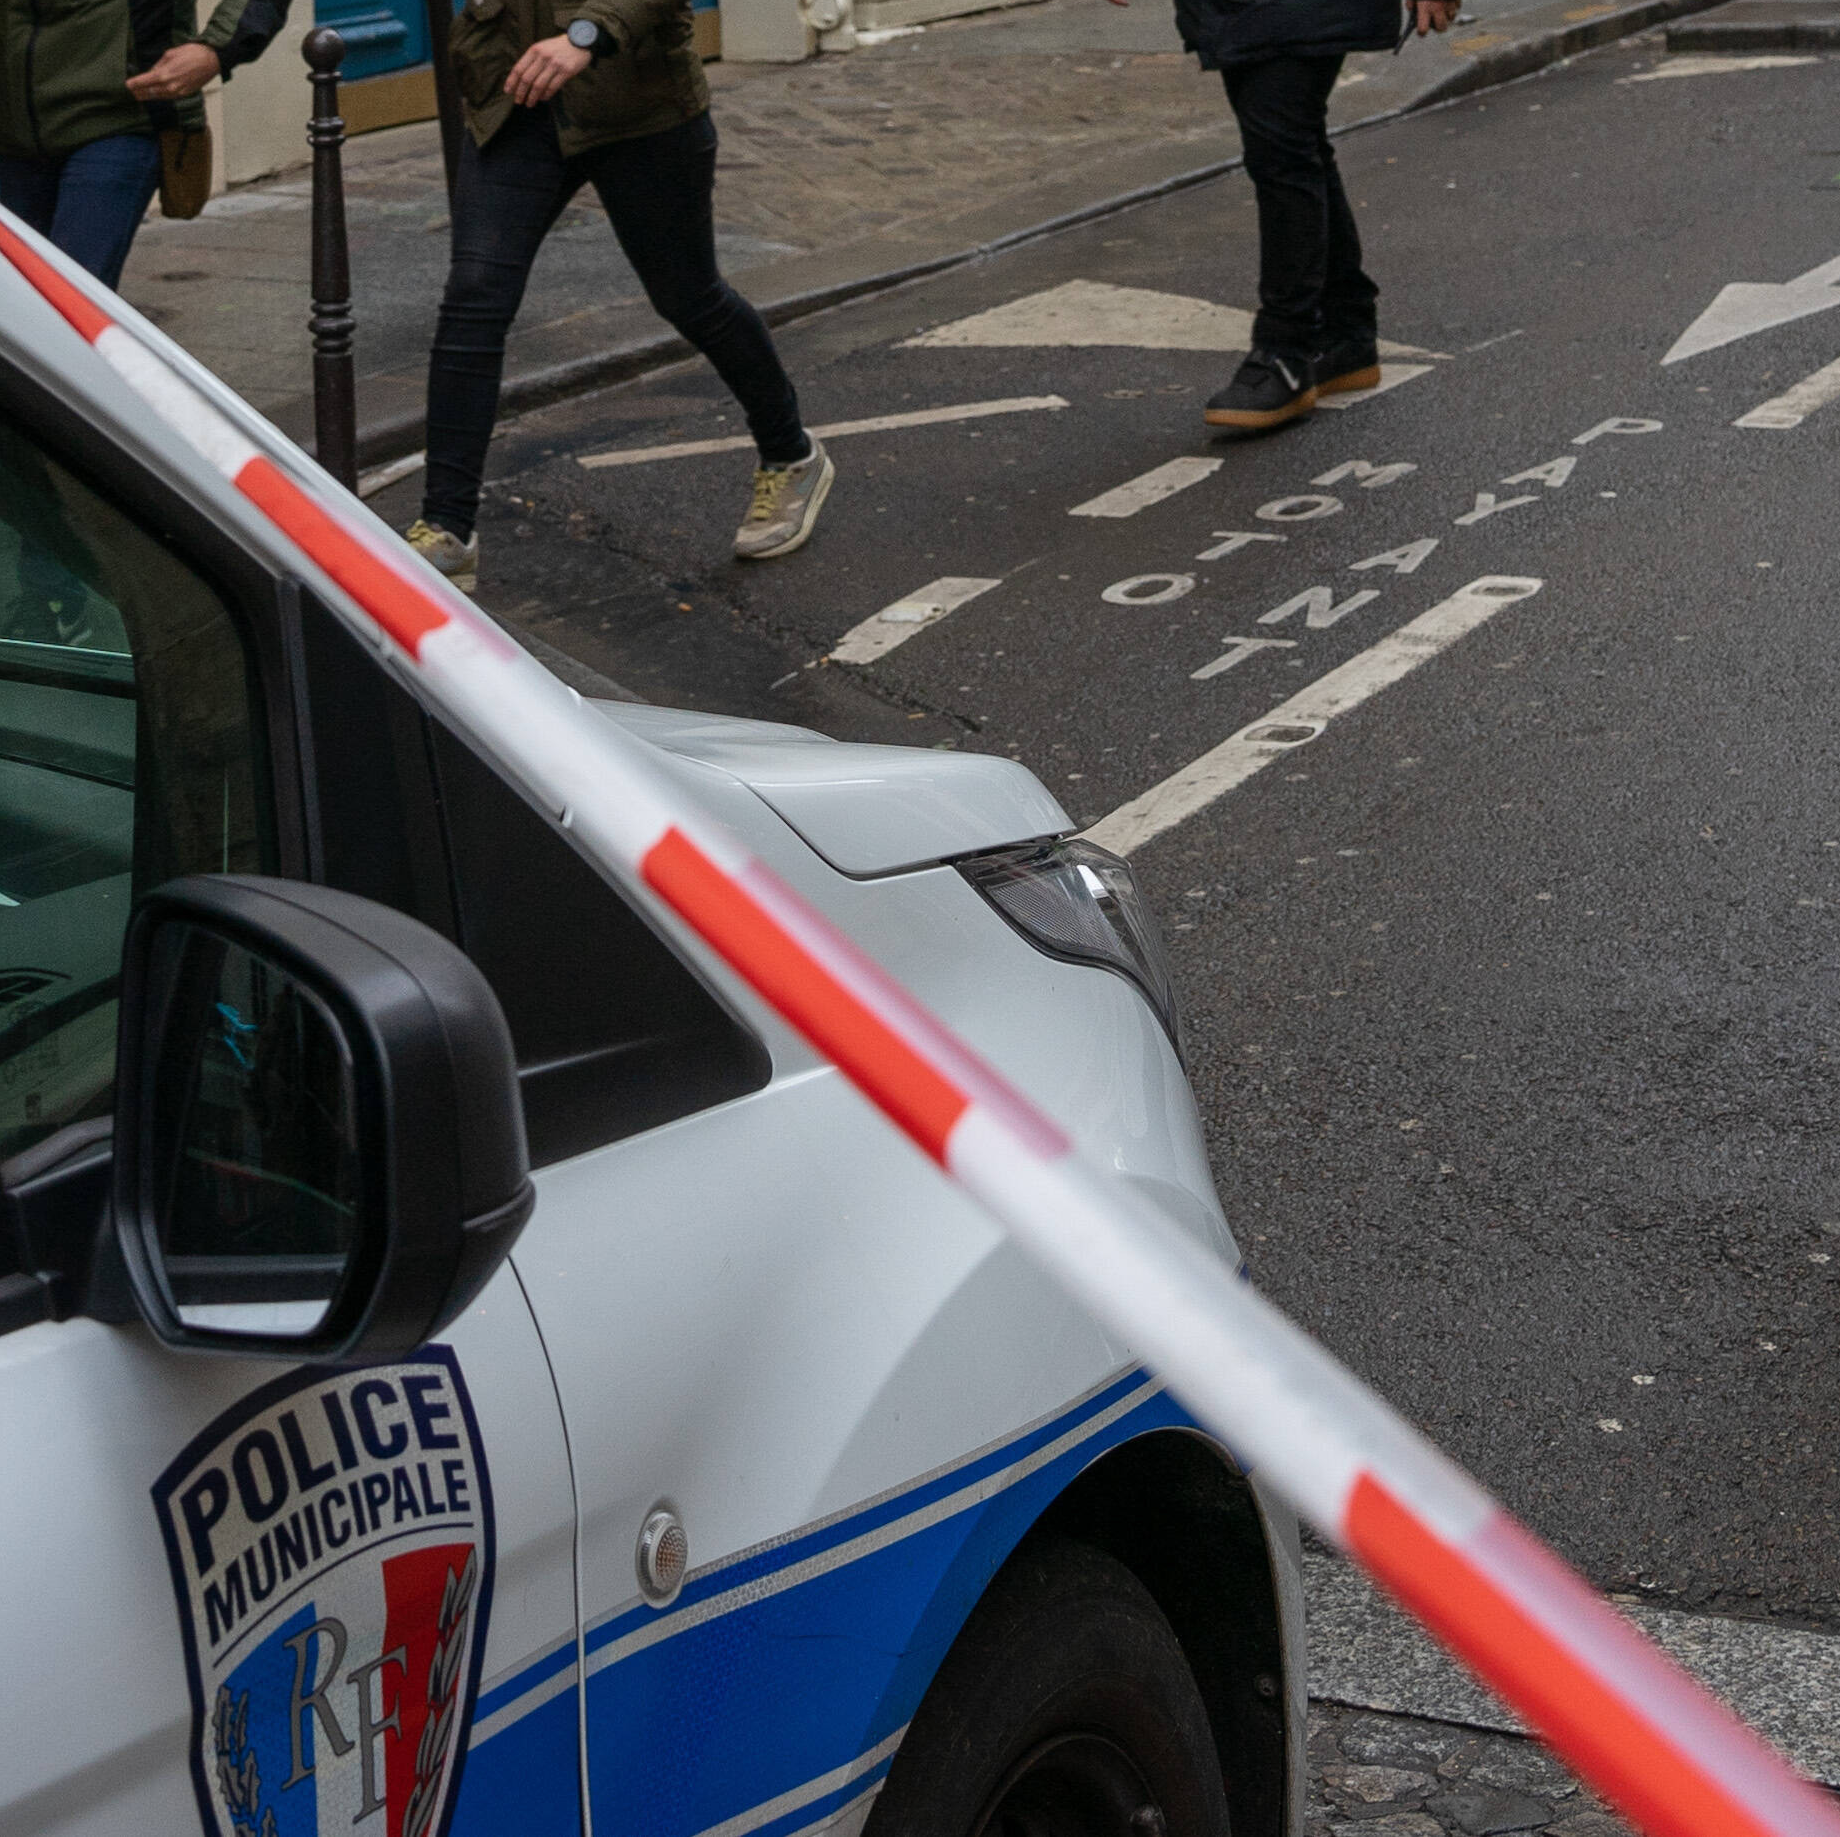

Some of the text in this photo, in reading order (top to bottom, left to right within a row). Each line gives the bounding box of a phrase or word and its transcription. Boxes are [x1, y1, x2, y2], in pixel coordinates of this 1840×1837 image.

[1100, 458, 1418, 606] MOTO
[1189, 416, 1664, 680] PAYANT
[179, 1374, 460, 1579] POLICE
[200, 1459, 472, 1648] MUNICIPALE
